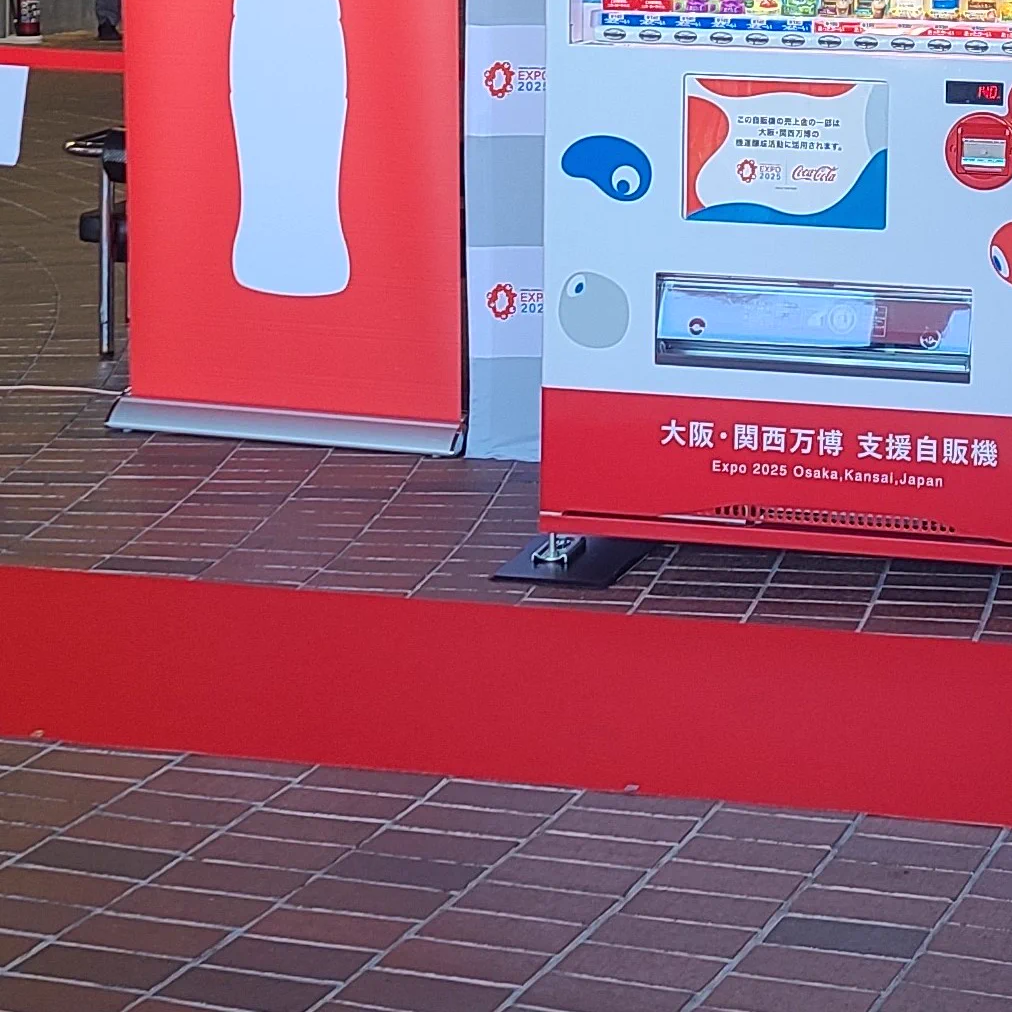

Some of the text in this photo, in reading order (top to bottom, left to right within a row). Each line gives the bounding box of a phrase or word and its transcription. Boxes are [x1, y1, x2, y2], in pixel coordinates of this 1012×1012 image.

[517, 81, 546, 92] 202
[792, 165, 838, 182] Coca-Cola
[520, 293, 544, 303] EXP
[521, 303, 544, 314] 202
[660, 419, 999, 468] 大阪・関西万博 支援自販機
[712, 460, 747, 475] Expo
[752, 463, 788, 477] 2025
